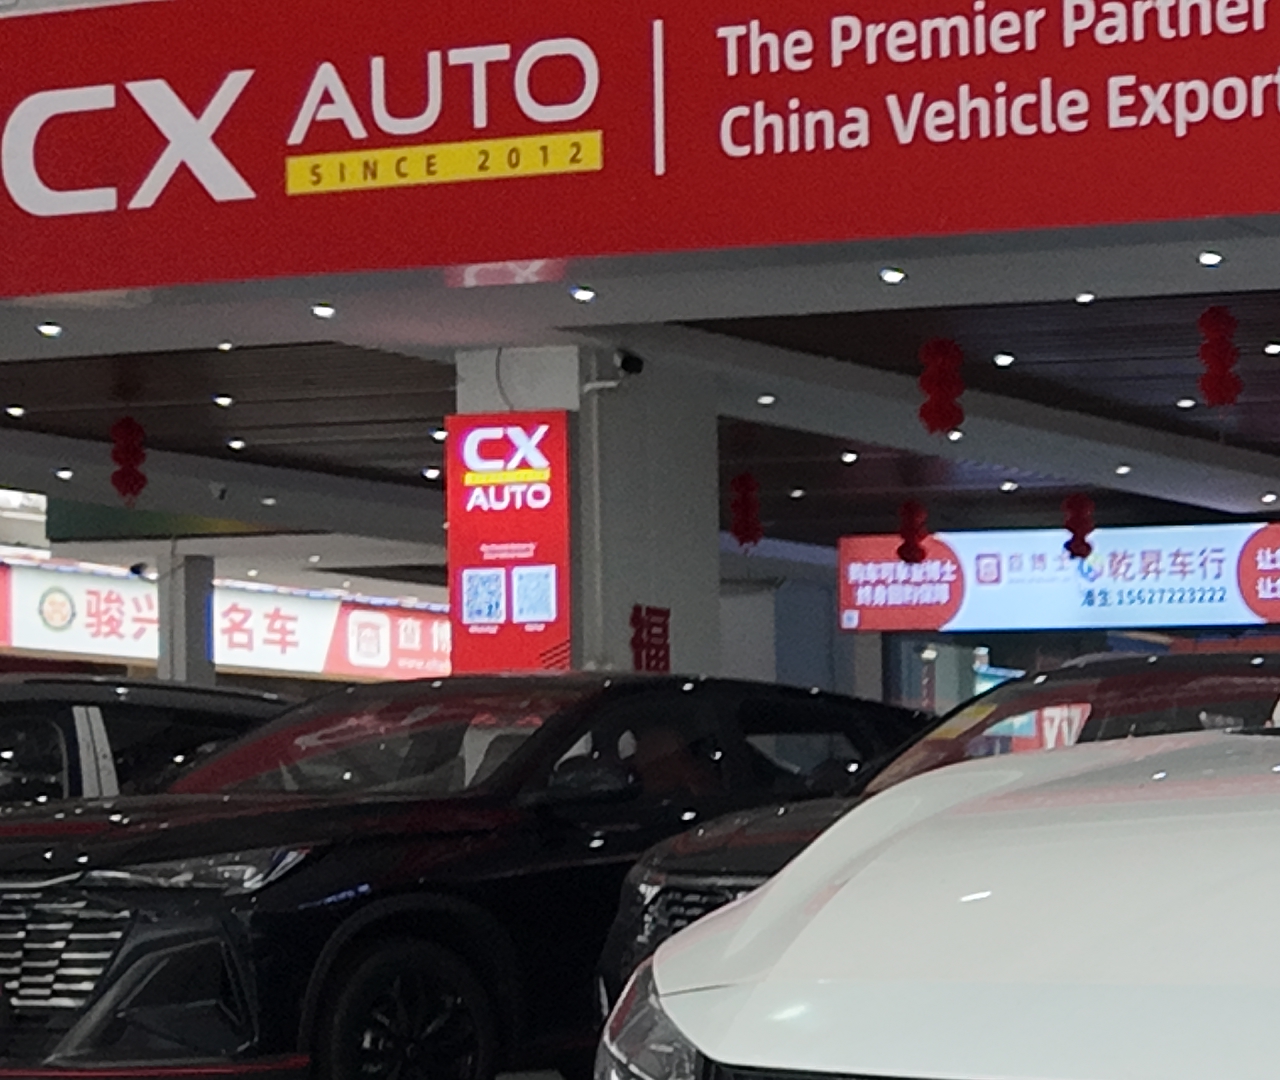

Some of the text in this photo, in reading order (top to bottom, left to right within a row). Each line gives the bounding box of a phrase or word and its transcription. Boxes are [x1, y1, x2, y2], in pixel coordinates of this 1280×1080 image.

[716, 23, 814, 77] The
[830, 0, 1046, 68] Premier
[1063, 0, 1268, 49] Partner
[1, 37, 599, 217] CX AUTO
[719, 102, 870, 157] China
[885, 76, 1089, 145] Vehicle
[310, 140, 585, 186] SINCE 2012
[463, 424, 550, 472] CX
[466, 485, 551, 512] AUTO
